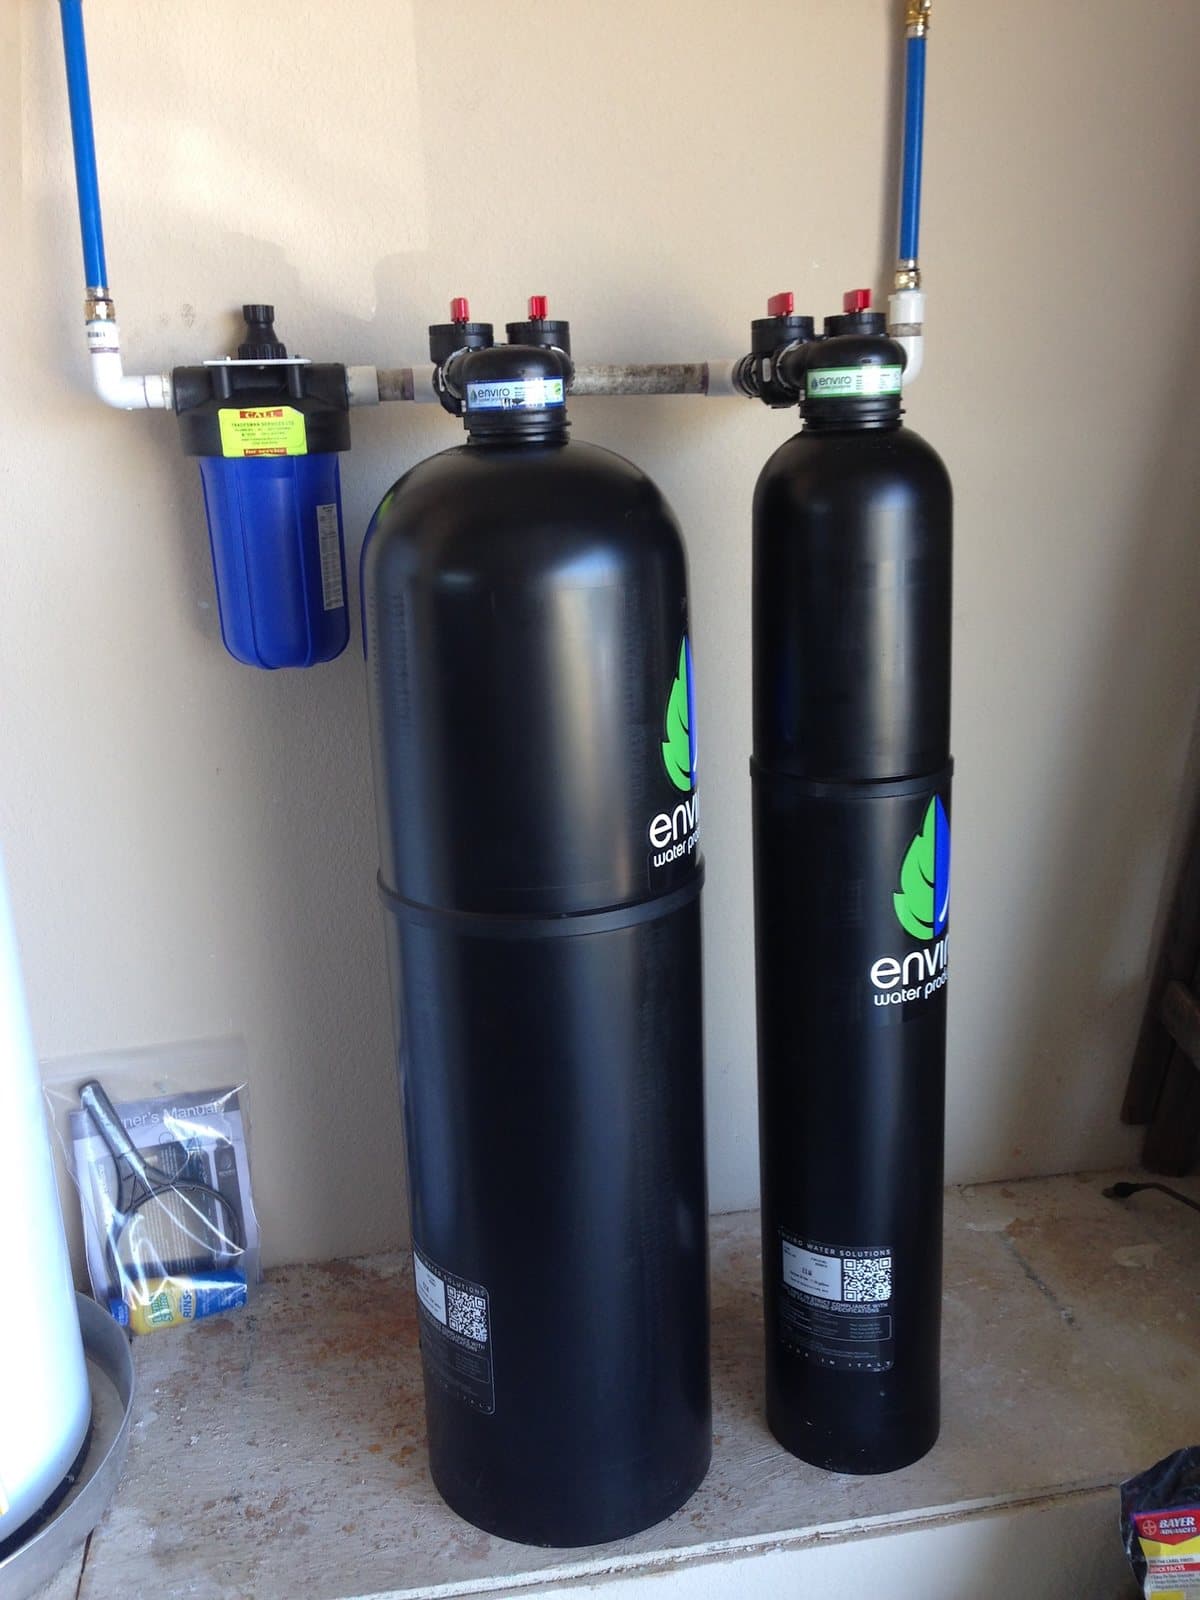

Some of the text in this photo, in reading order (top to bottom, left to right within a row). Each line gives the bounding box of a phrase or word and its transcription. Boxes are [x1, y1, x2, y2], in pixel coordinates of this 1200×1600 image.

[819, 376, 852, 386] enviro
[477, 388, 510, 399] enviro
[653, 840, 687, 868] water
[873, 986, 922, 1006] water
[121, 1111, 160, 1130] ner's
[806, 1243, 836, 1255] WATER
[839, 1249, 891, 1258] SOLUTIONS
[1160, 1516, 1195, 1528] BAYER
